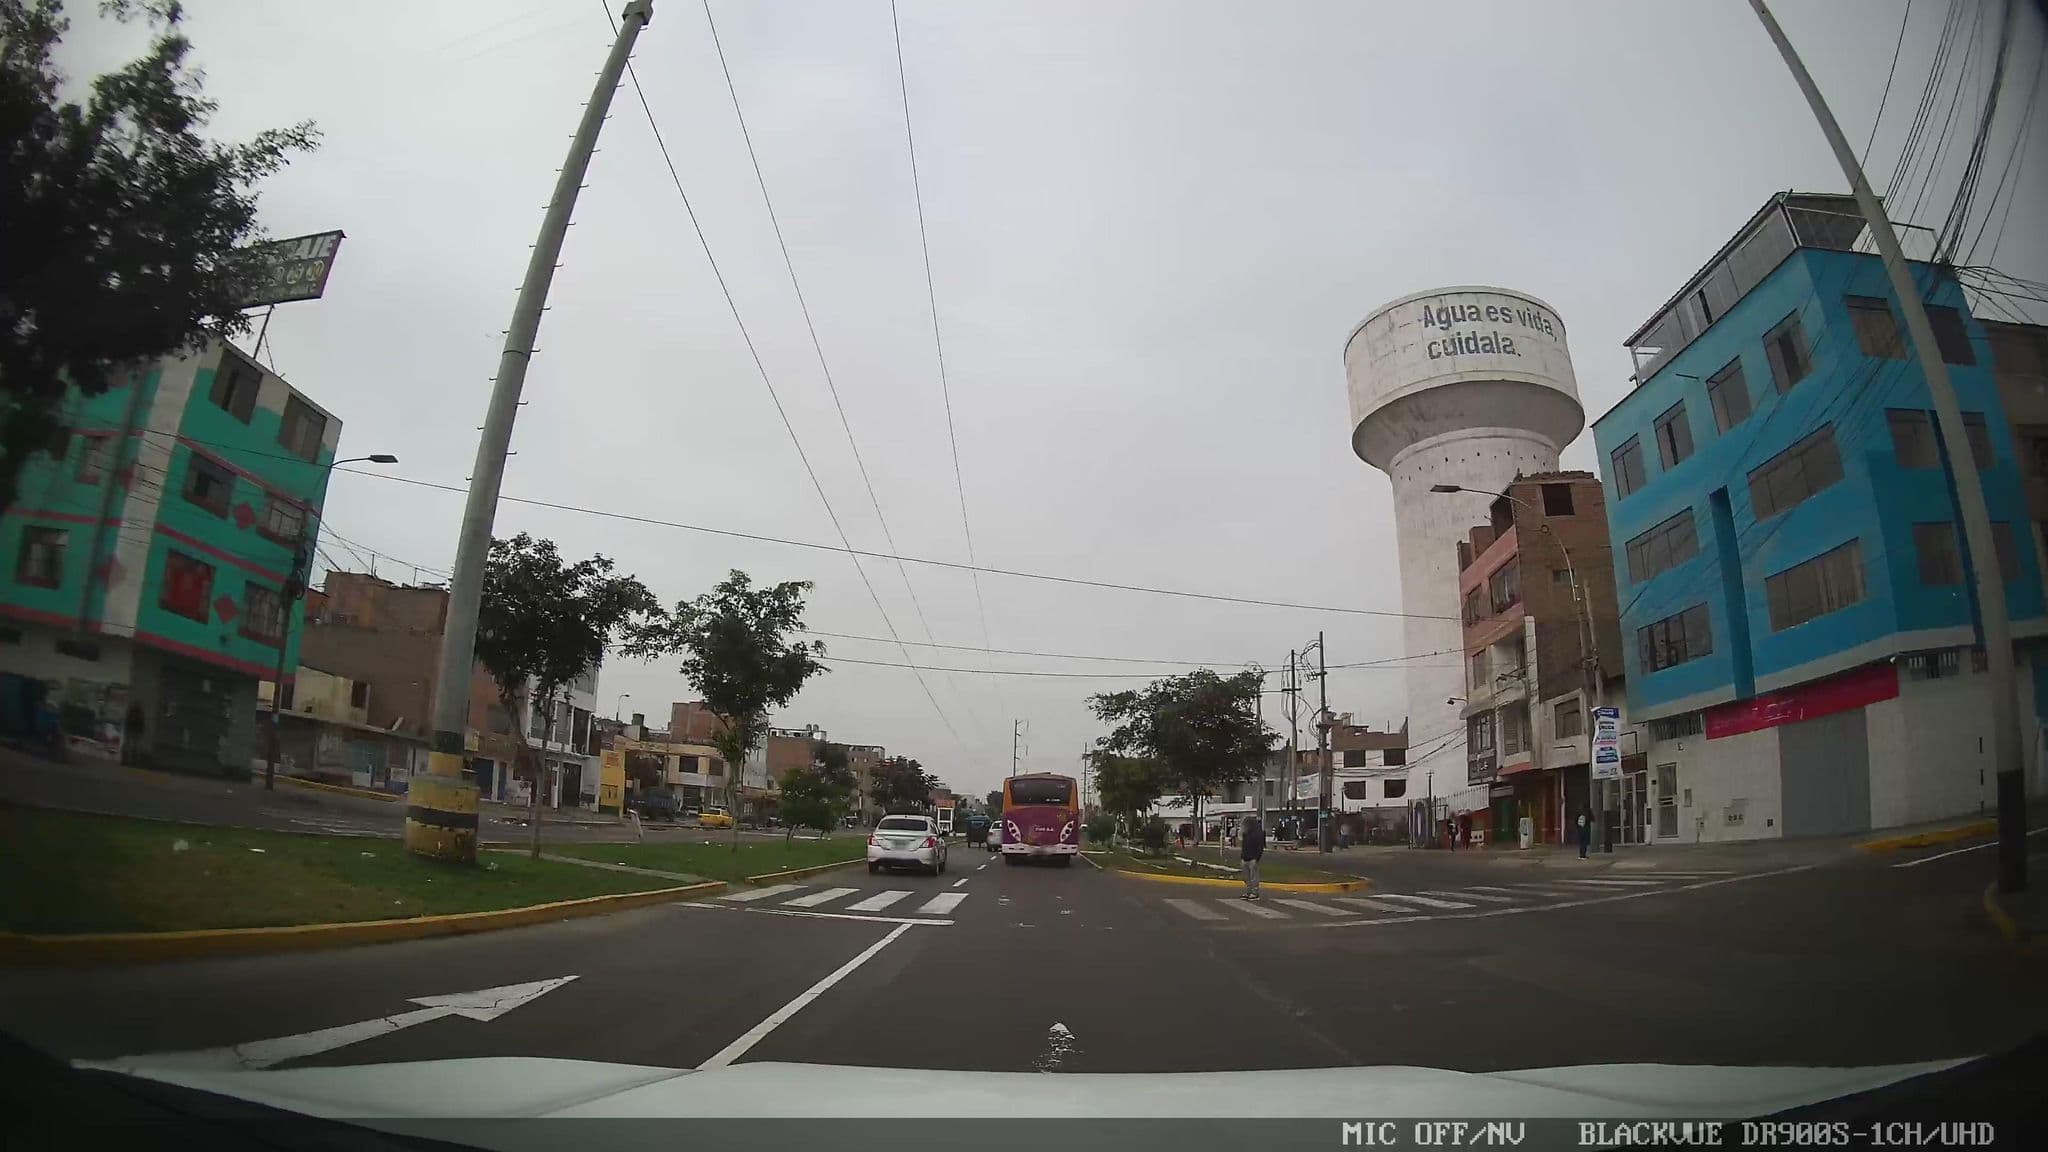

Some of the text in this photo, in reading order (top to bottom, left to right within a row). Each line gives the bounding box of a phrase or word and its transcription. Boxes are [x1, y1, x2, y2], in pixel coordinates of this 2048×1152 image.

[1423, 304, 1558, 342] Agua es vida,
